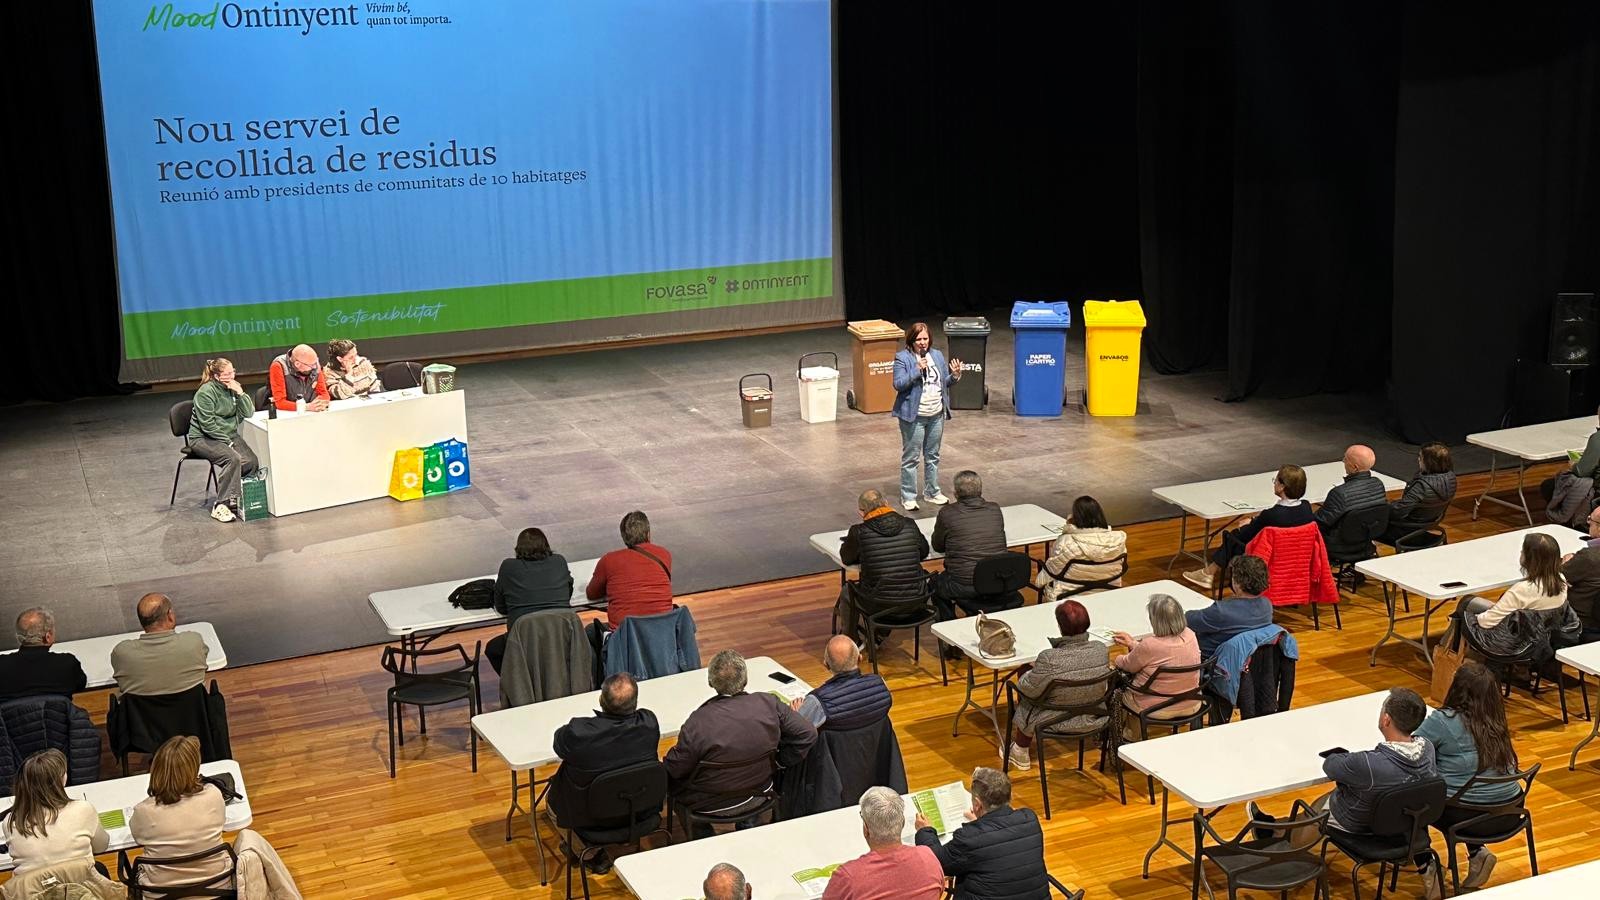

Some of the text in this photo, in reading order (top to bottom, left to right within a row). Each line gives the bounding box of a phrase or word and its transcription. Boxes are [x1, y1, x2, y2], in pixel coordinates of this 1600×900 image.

[142, 1, 359, 36] Mood Ontinyent
[366, 1, 411, 14] Vivim bé,
[366, 14, 452, 28] quan tot importa.
[153, 107, 400, 144] Nou servei de
[157, 140, 497, 181] recollida de residus
[160, 169, 587, 203] Reunió amb presidents de comunitats de 10 habitatges
[325, 302, 447, 329] Sostenibilitat
[960, 363, 982, 372] ESTA
